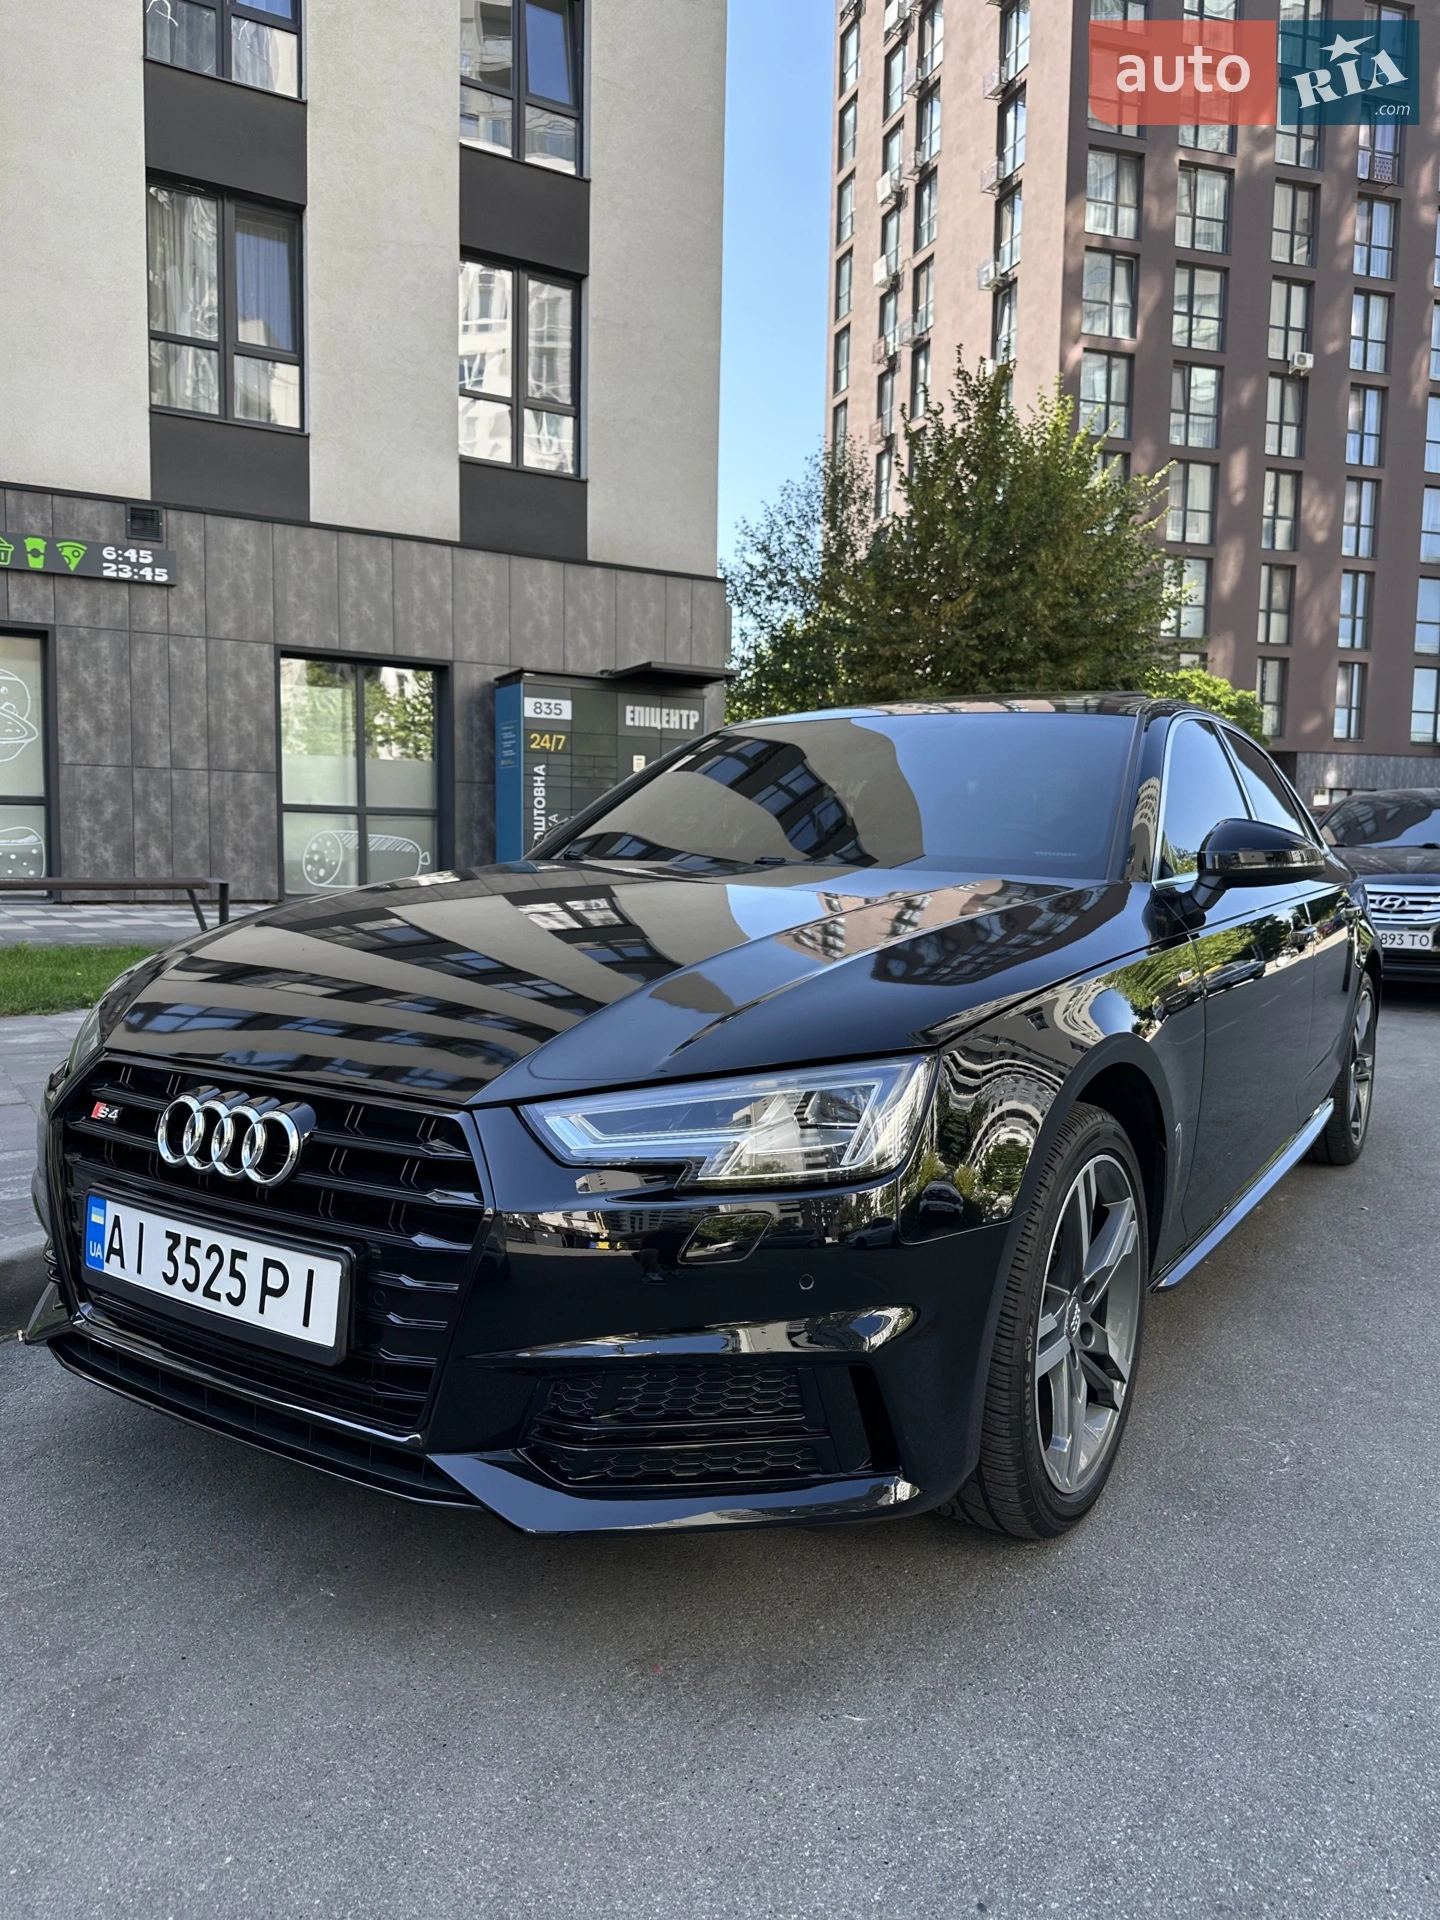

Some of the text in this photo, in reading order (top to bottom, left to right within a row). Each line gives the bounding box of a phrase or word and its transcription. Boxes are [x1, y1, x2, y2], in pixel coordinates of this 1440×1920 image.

[102, 546, 153, 564] 6:45
[102, 562, 168, 582] 23:45
[533, 701, 563, 716] 835
[625, 705, 700, 731] ЕПІЦЕНТР
[530, 733, 566, 752] 24/7
[1408, 934, 1430, 947] TO
[98, 1105, 119, 1121] S4
[89, 1241, 103, 1260] UA
[105, 1214, 315, 1328] AI 3525 PI
